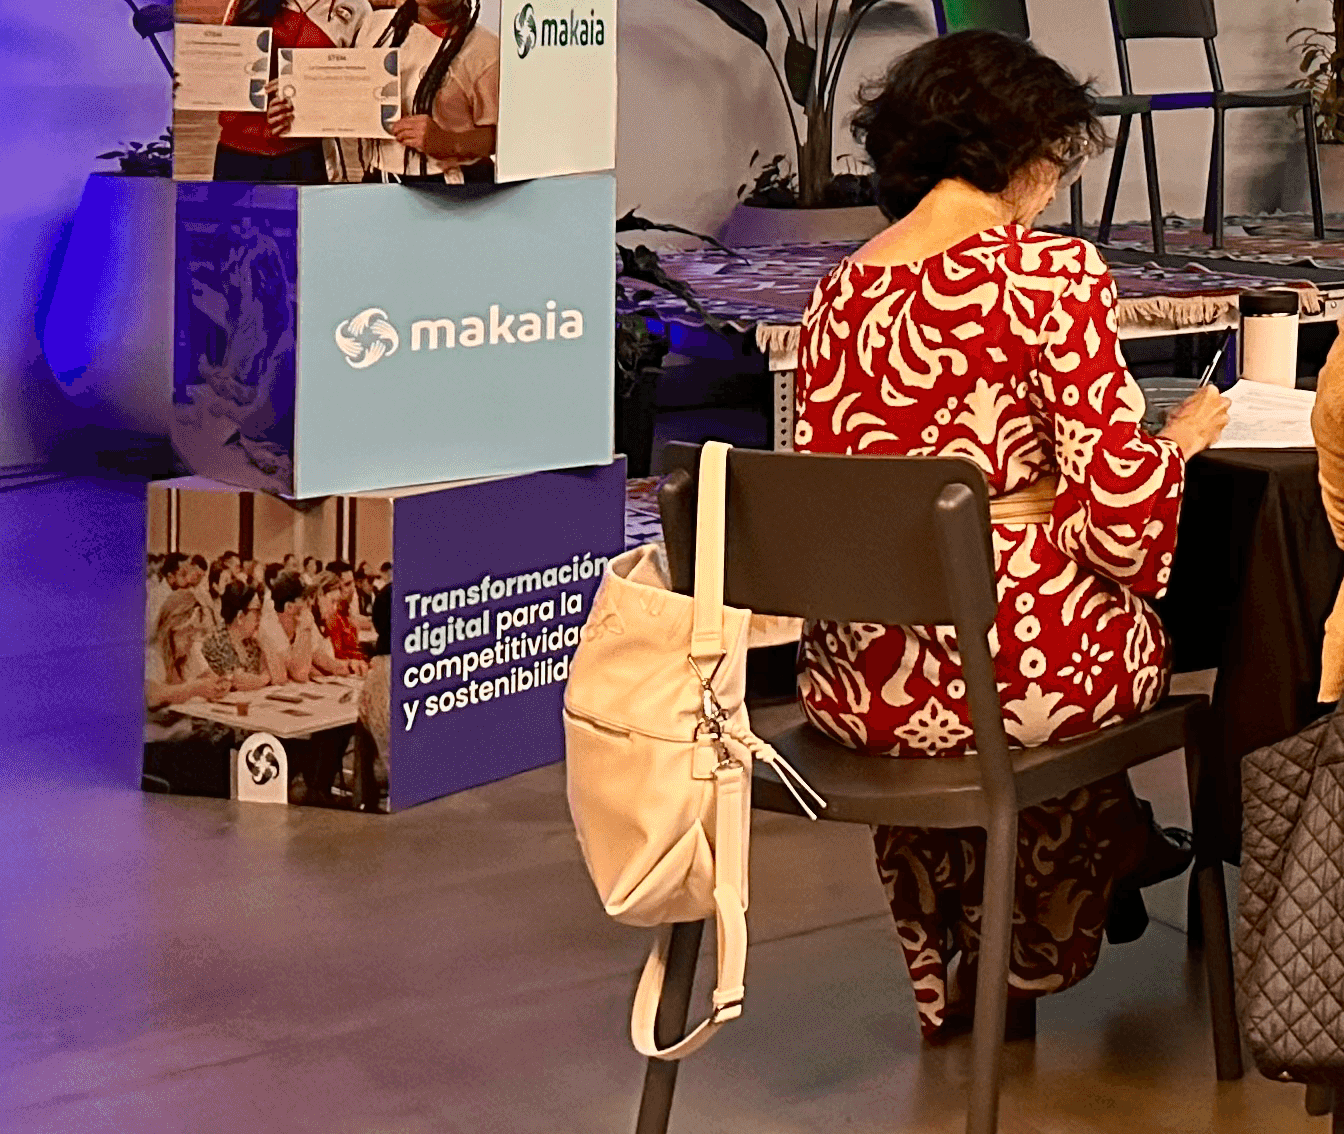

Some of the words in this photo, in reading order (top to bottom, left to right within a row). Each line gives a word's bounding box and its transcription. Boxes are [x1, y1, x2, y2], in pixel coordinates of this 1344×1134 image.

[541, 8, 605, 47] makaia
[411, 299, 584, 352] makaia
[405, 552, 609, 620] Transformación
[403, 623, 582, 688] competitivida
[404, 610, 490, 656] digital
[496, 600, 555, 641] para
[560, 592, 583, 616] la
[403, 700, 420, 732] y
[425, 654, 571, 716] sostenibilid
